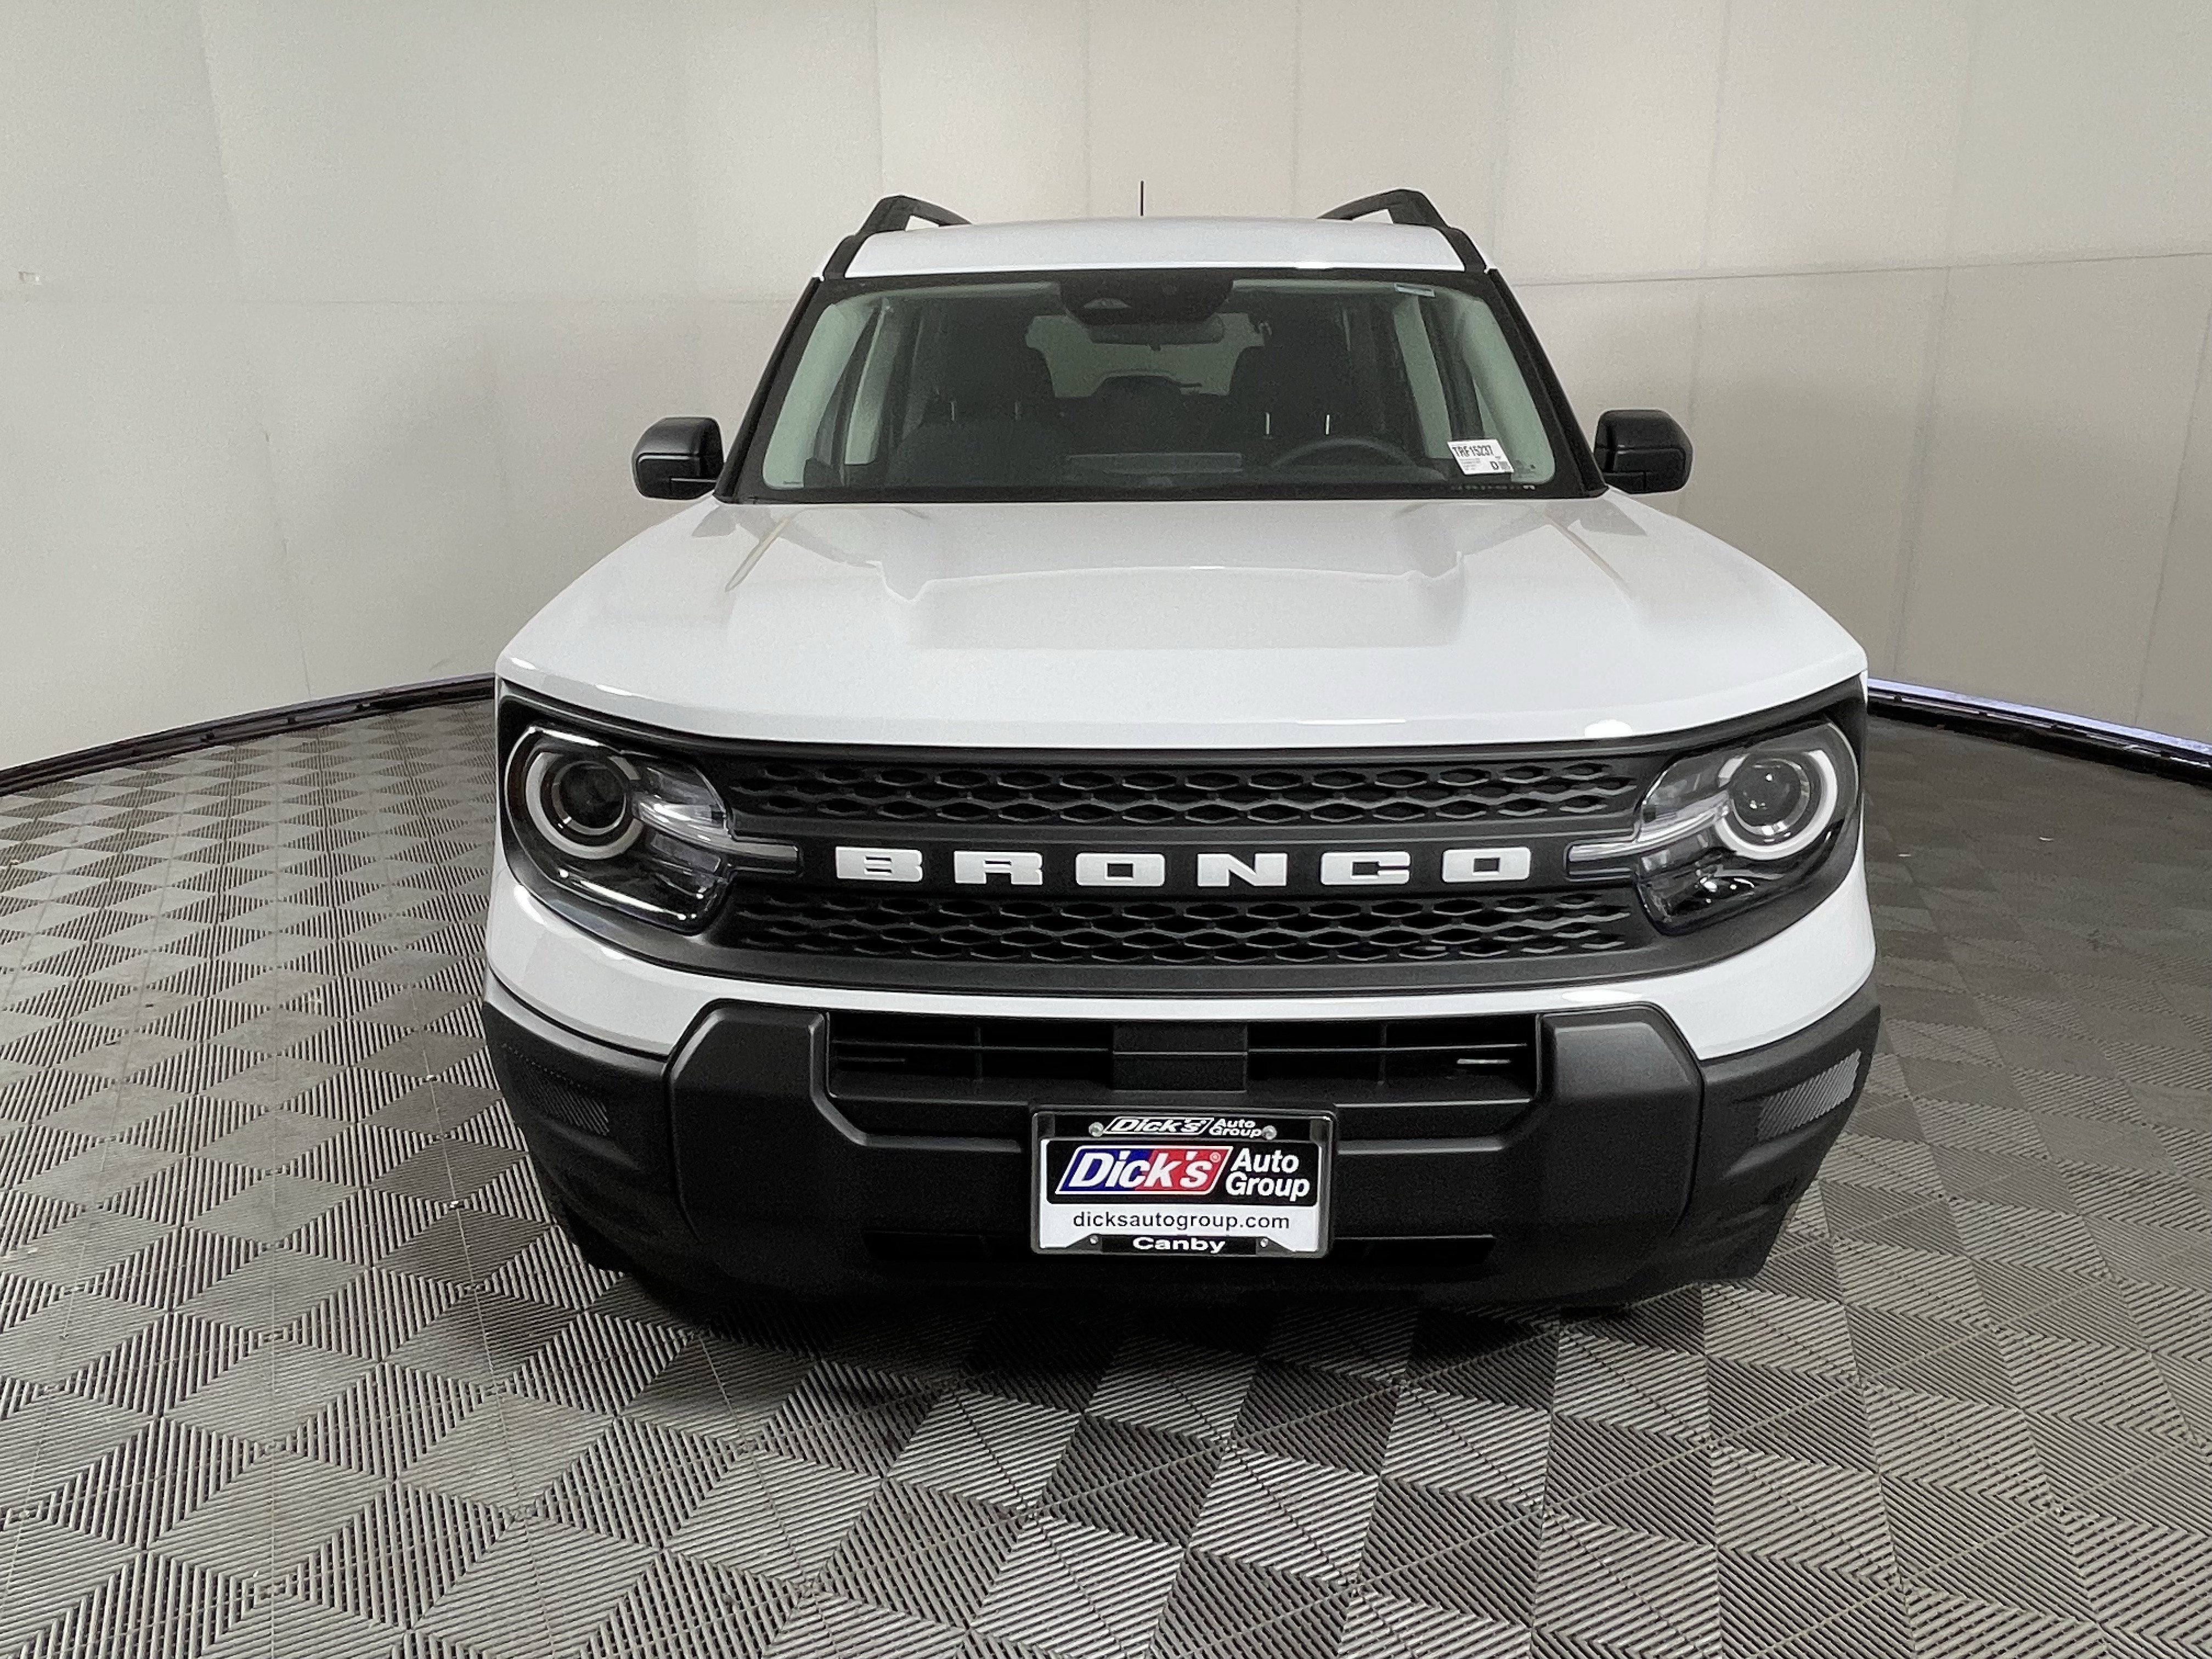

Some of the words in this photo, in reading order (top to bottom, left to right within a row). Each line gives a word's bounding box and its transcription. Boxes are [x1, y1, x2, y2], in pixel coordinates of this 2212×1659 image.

[835, 847, 1531, 887] BRONCO
[1209, 1126, 1262, 1138] Group
[1213, 1118, 1256, 1128] Auto
[1230, 1148, 1300, 1173] Auto
[1225, 1172, 1310, 1201] Group
[1073, 1211, 1290, 1231] dicksautogroup.com
[1132, 1237, 1226, 1253] Canby
